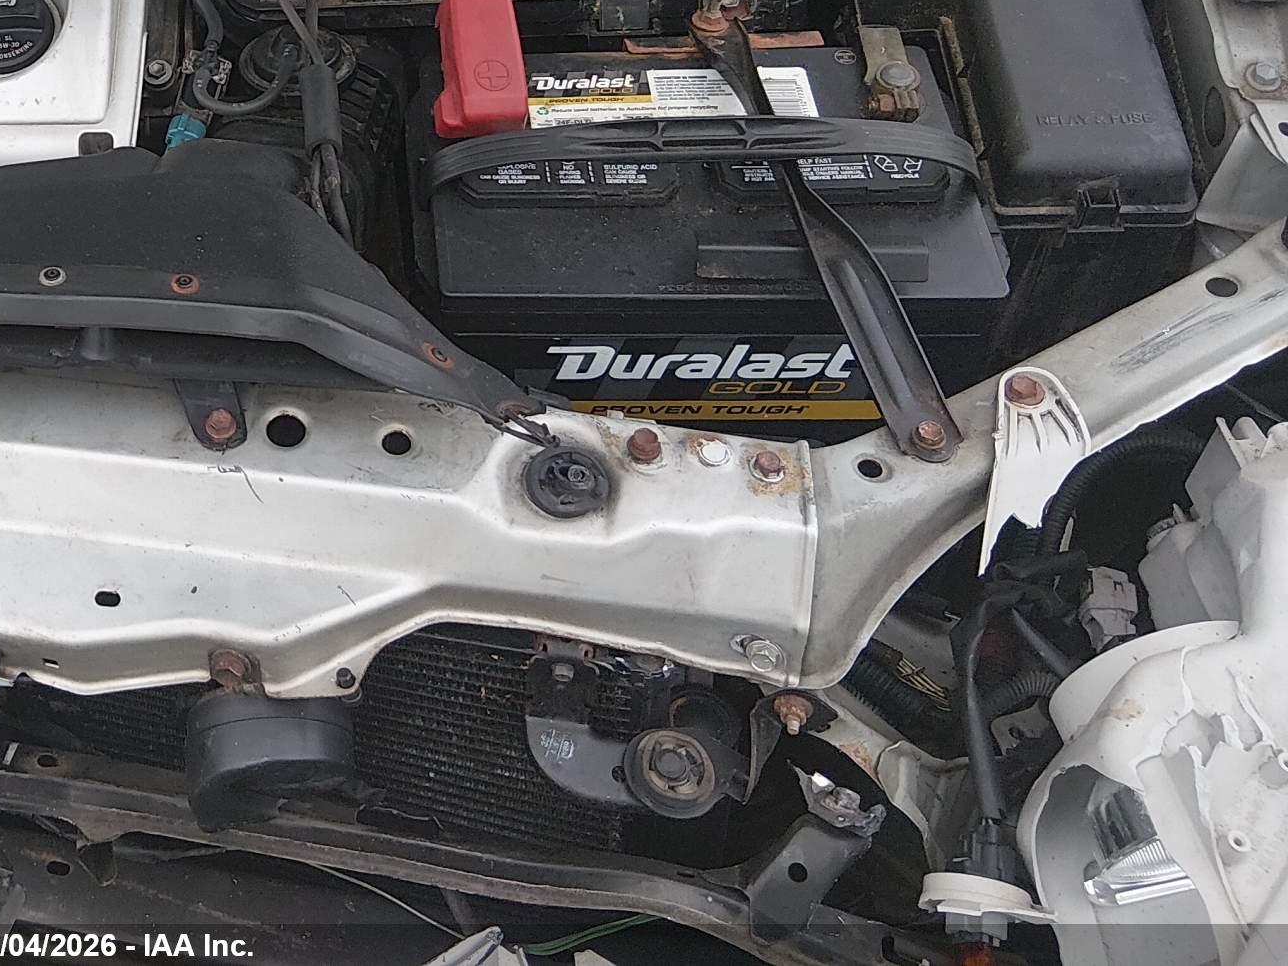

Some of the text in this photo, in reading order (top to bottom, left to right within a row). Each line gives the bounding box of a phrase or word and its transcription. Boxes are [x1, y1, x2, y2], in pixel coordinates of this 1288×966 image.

[531, 74, 635, 91] Duralast
[1109, 113, 1154, 125] FUSE
[545, 343, 858, 380] Duralast
[708, 381, 847, 395] GOLD
[590, 404, 805, 415] PROVEN TOUGH
